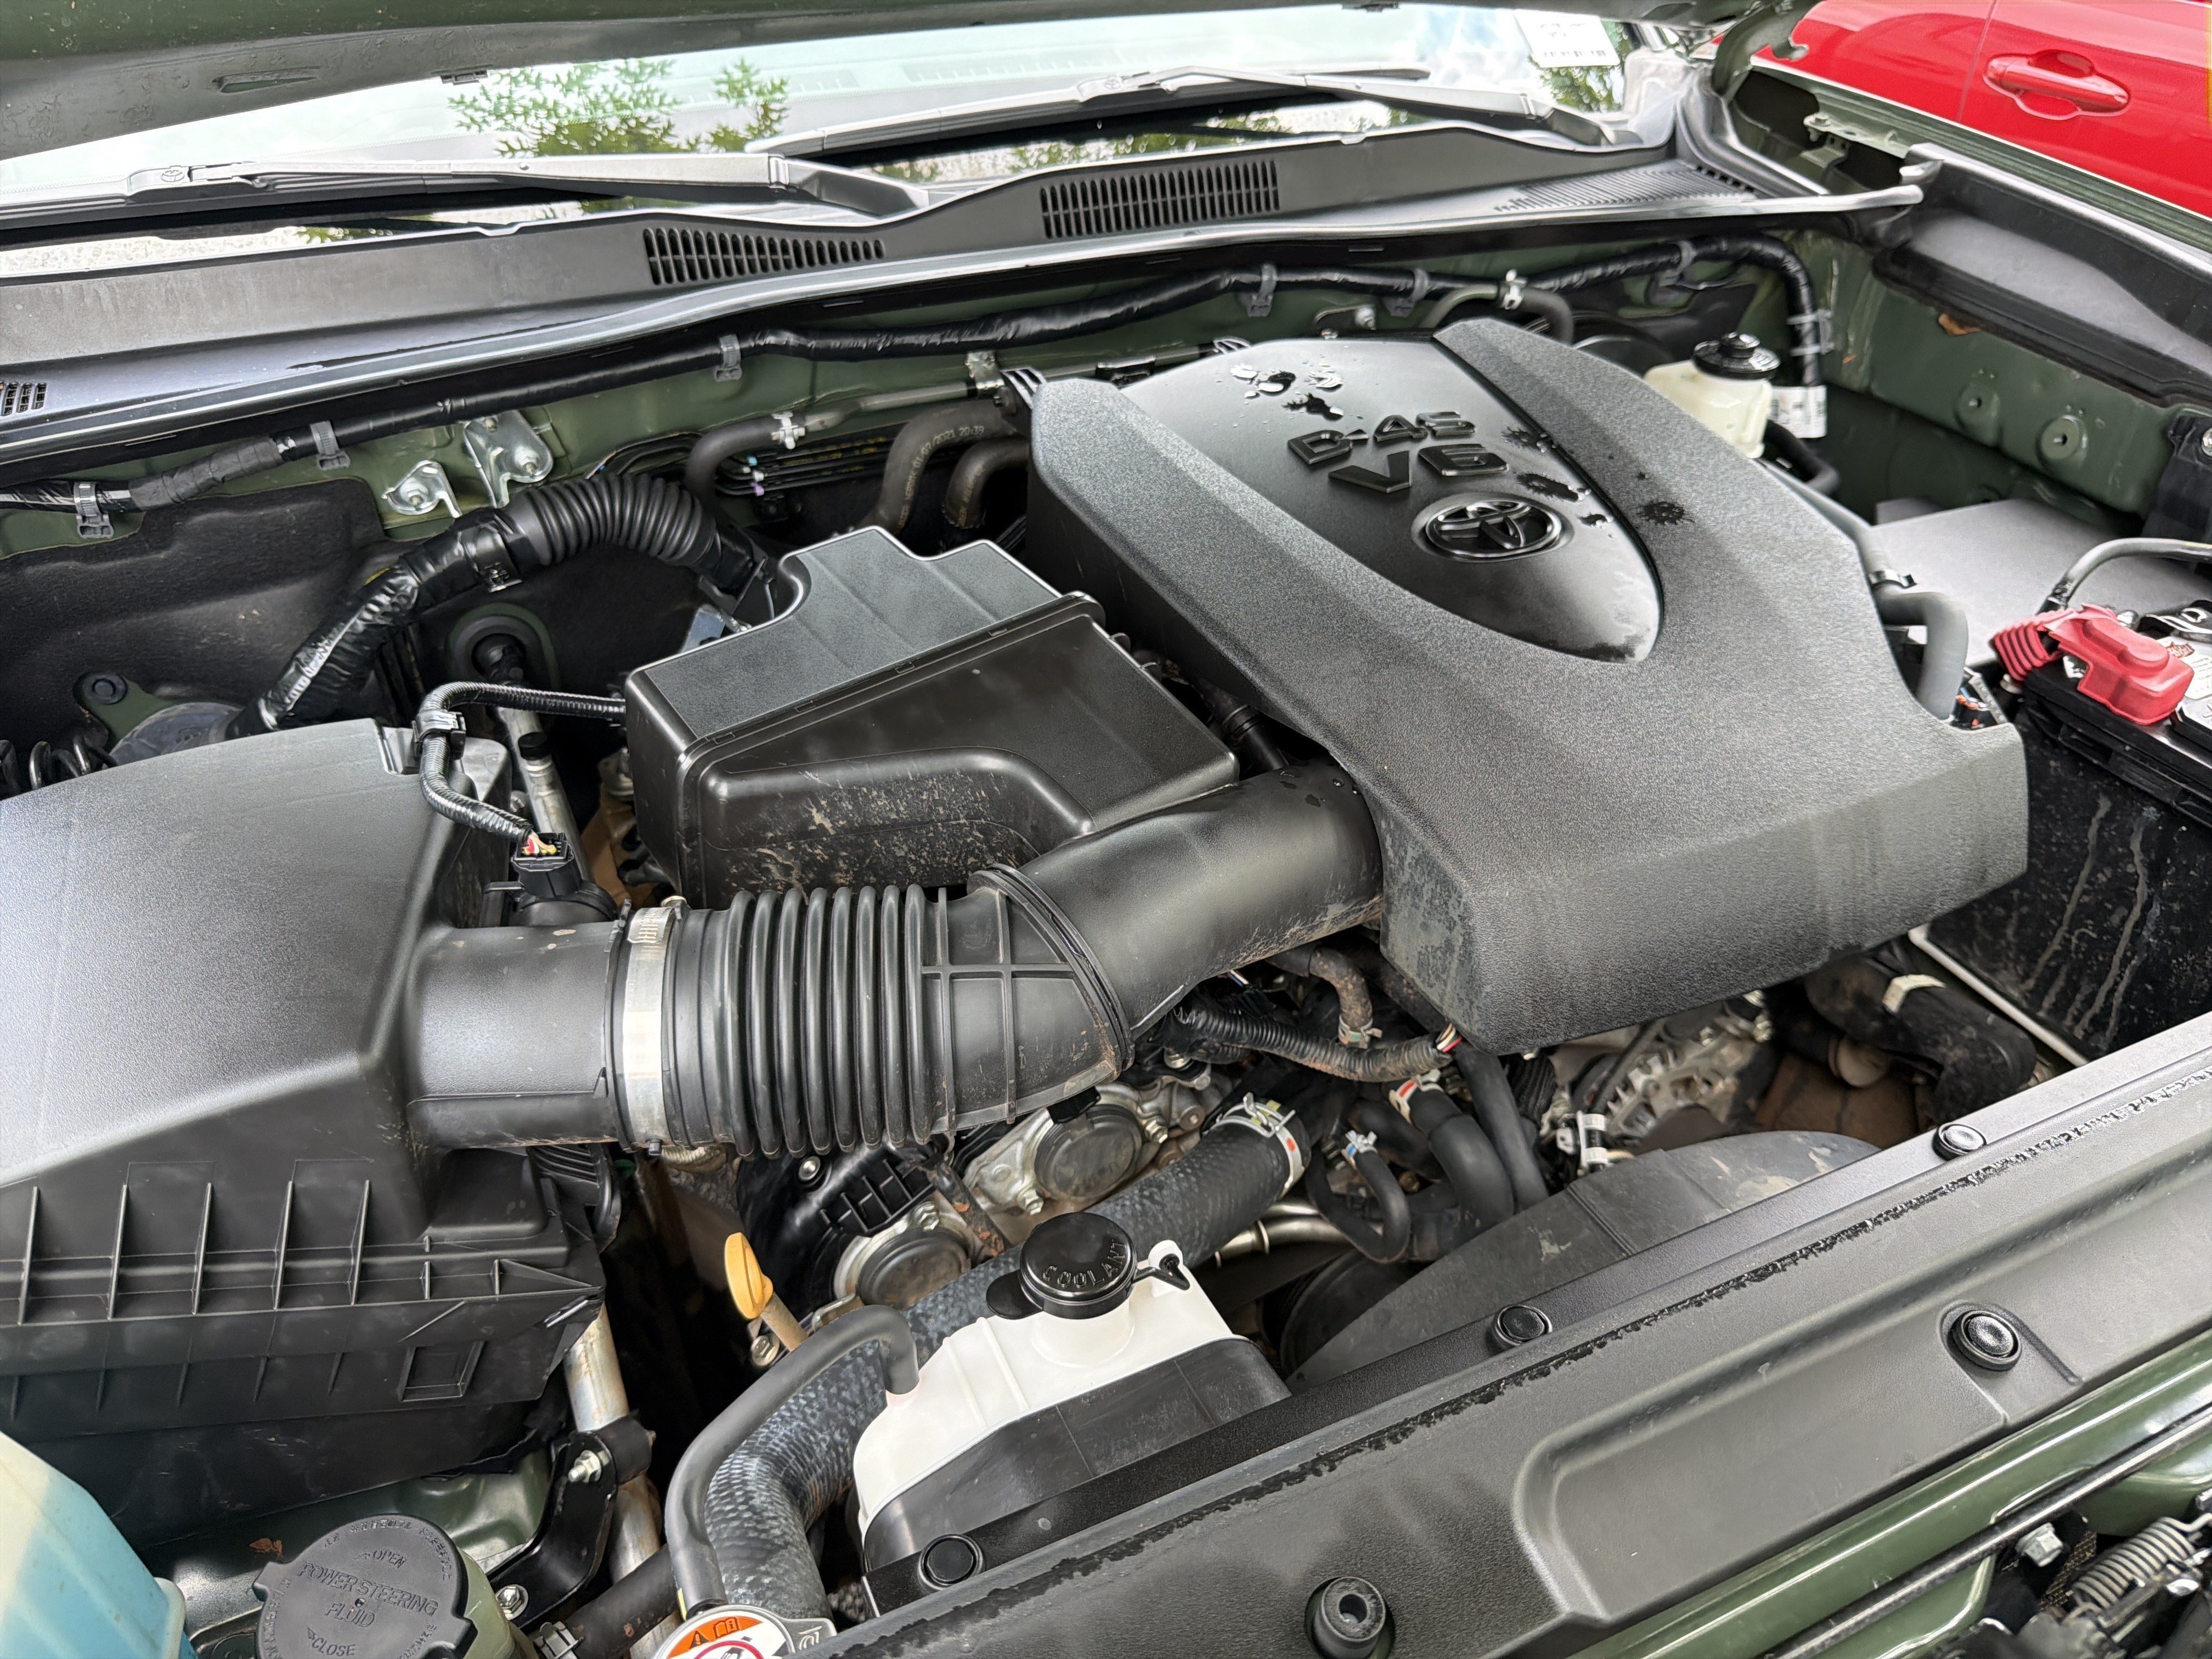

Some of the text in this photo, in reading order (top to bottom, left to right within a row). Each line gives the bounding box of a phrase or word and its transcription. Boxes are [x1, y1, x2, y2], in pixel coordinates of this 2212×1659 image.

[1328, 443, 1510, 494] V6
[1042, 1239, 1127, 1288] COOLANT
[372, 1549, 408, 1569] OPEN
[298, 1562, 439, 1617] POWER STEERING
[325, 1601, 375, 1628] FLUID
[311, 1635, 356, 1657] CLOSE
